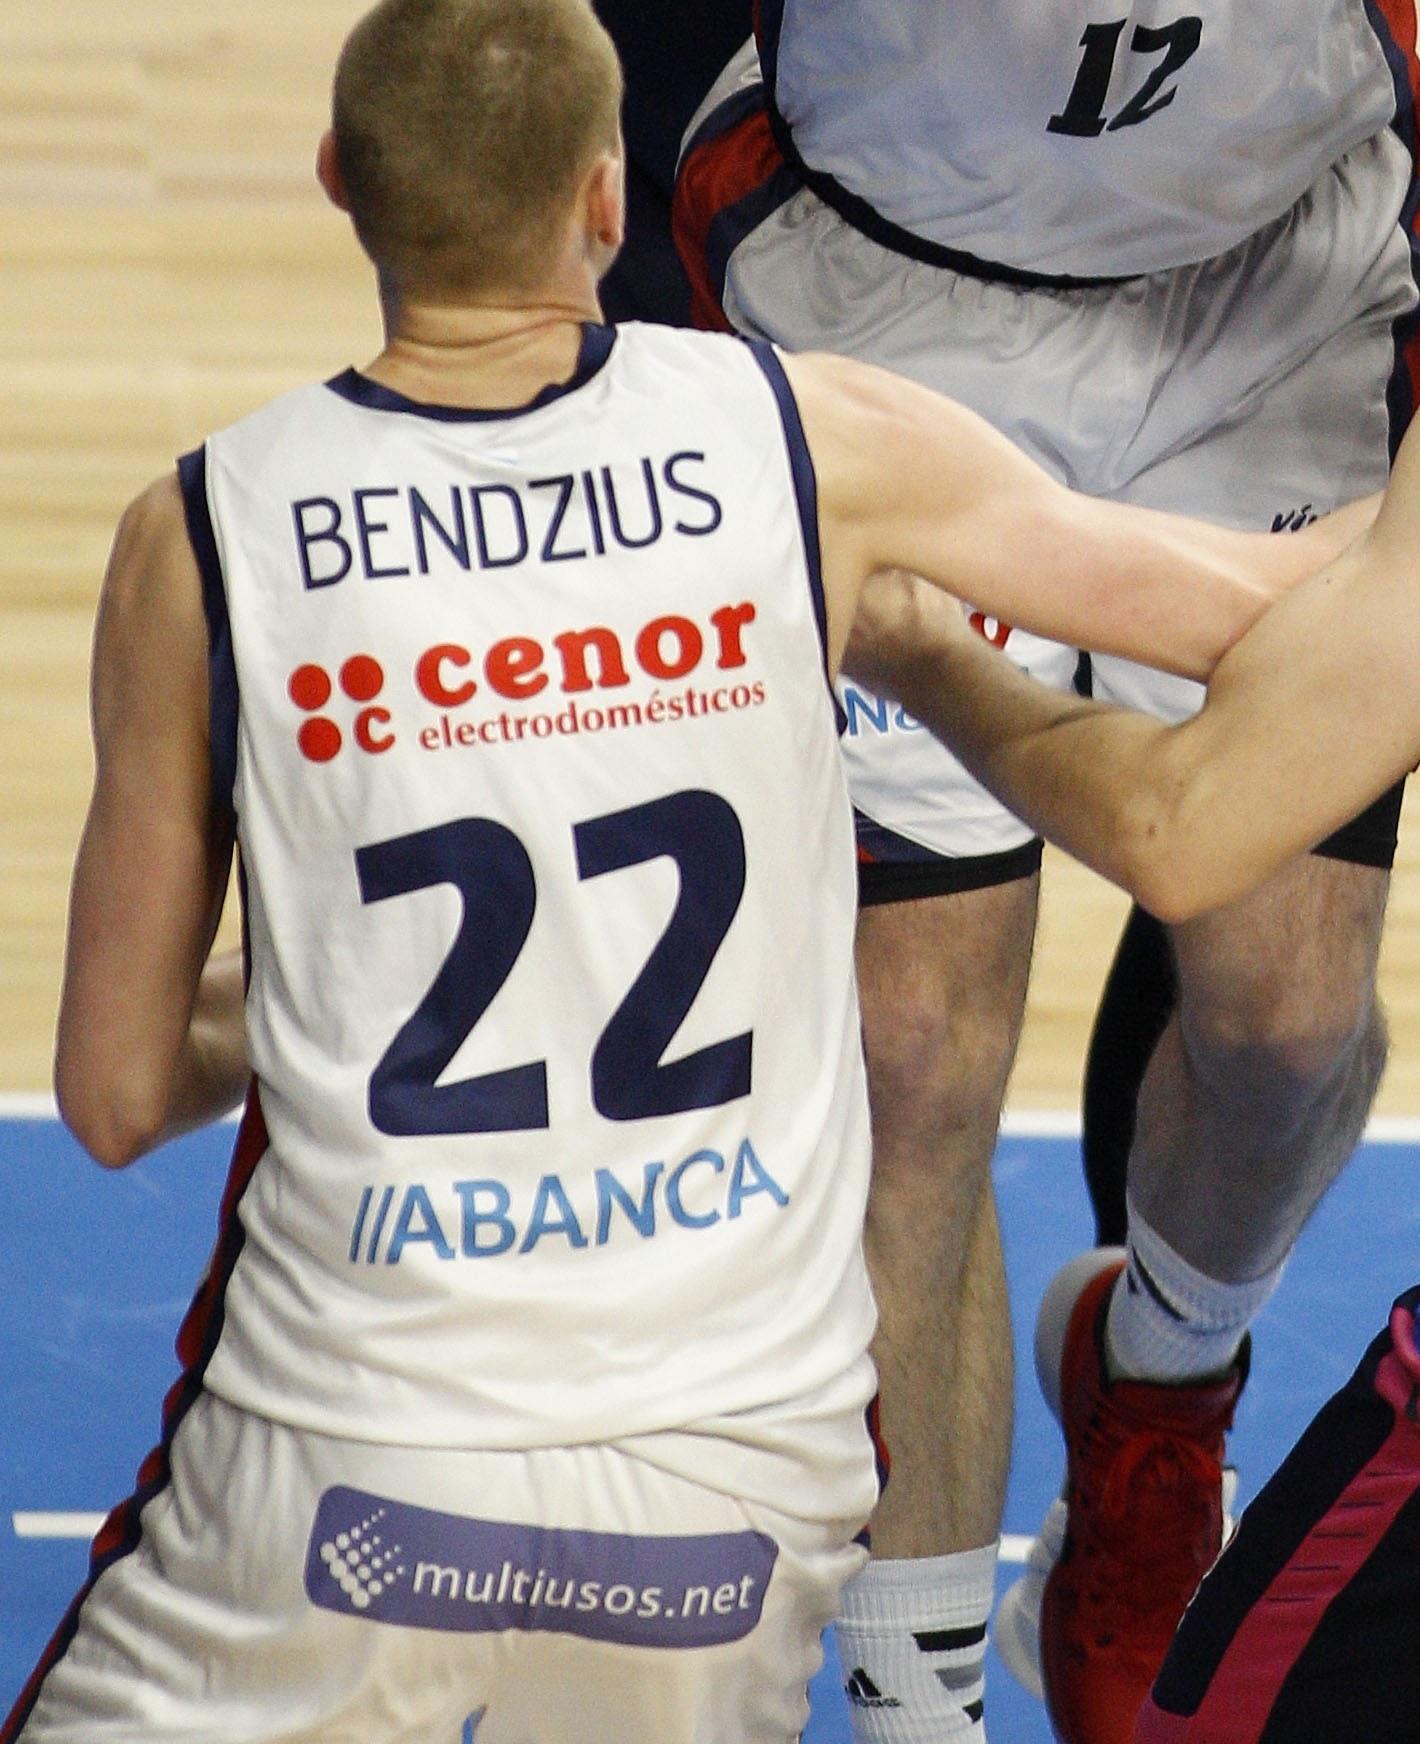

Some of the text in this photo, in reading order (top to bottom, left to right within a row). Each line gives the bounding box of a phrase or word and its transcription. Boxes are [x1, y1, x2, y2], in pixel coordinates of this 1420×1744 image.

[1045, 16, 1203, 138] 12
[291, 451, 724, 590] BENDZIUS
[415, 601, 757, 709] cenor
[419, 679, 766, 752] electrodomésticos
[354, 788, 754, 1137] 22
[412, 1556, 756, 1620] multiusos.net
